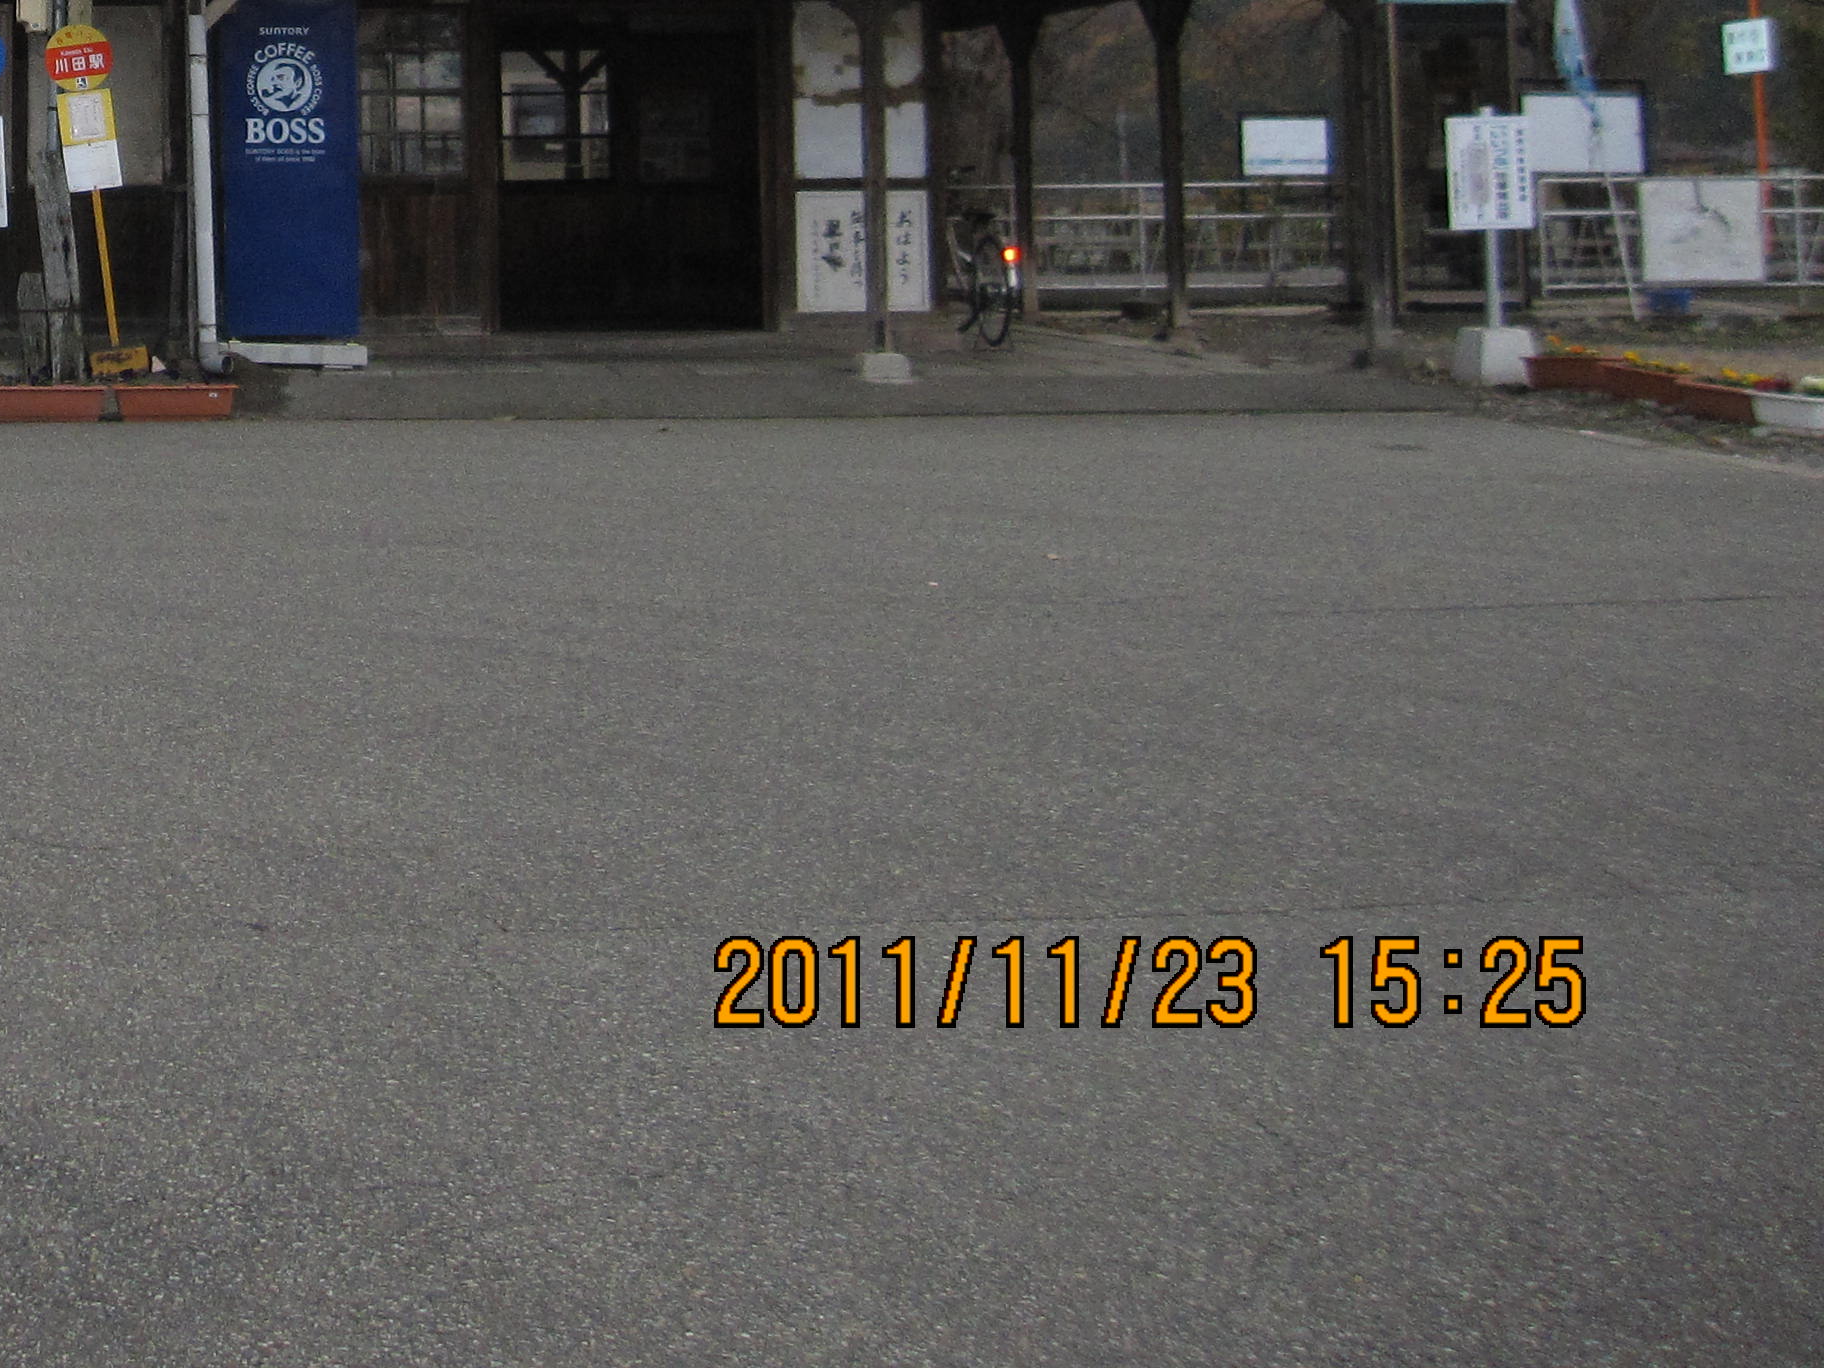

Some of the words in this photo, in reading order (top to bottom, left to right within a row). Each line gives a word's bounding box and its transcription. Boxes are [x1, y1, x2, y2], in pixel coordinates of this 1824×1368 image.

[259, 26, 310, 36] SUNTORY
[55, 53, 105, 74] 川田駅
[254, 42, 316, 65] COFFEE
[245, 117, 326, 144] BOSS
